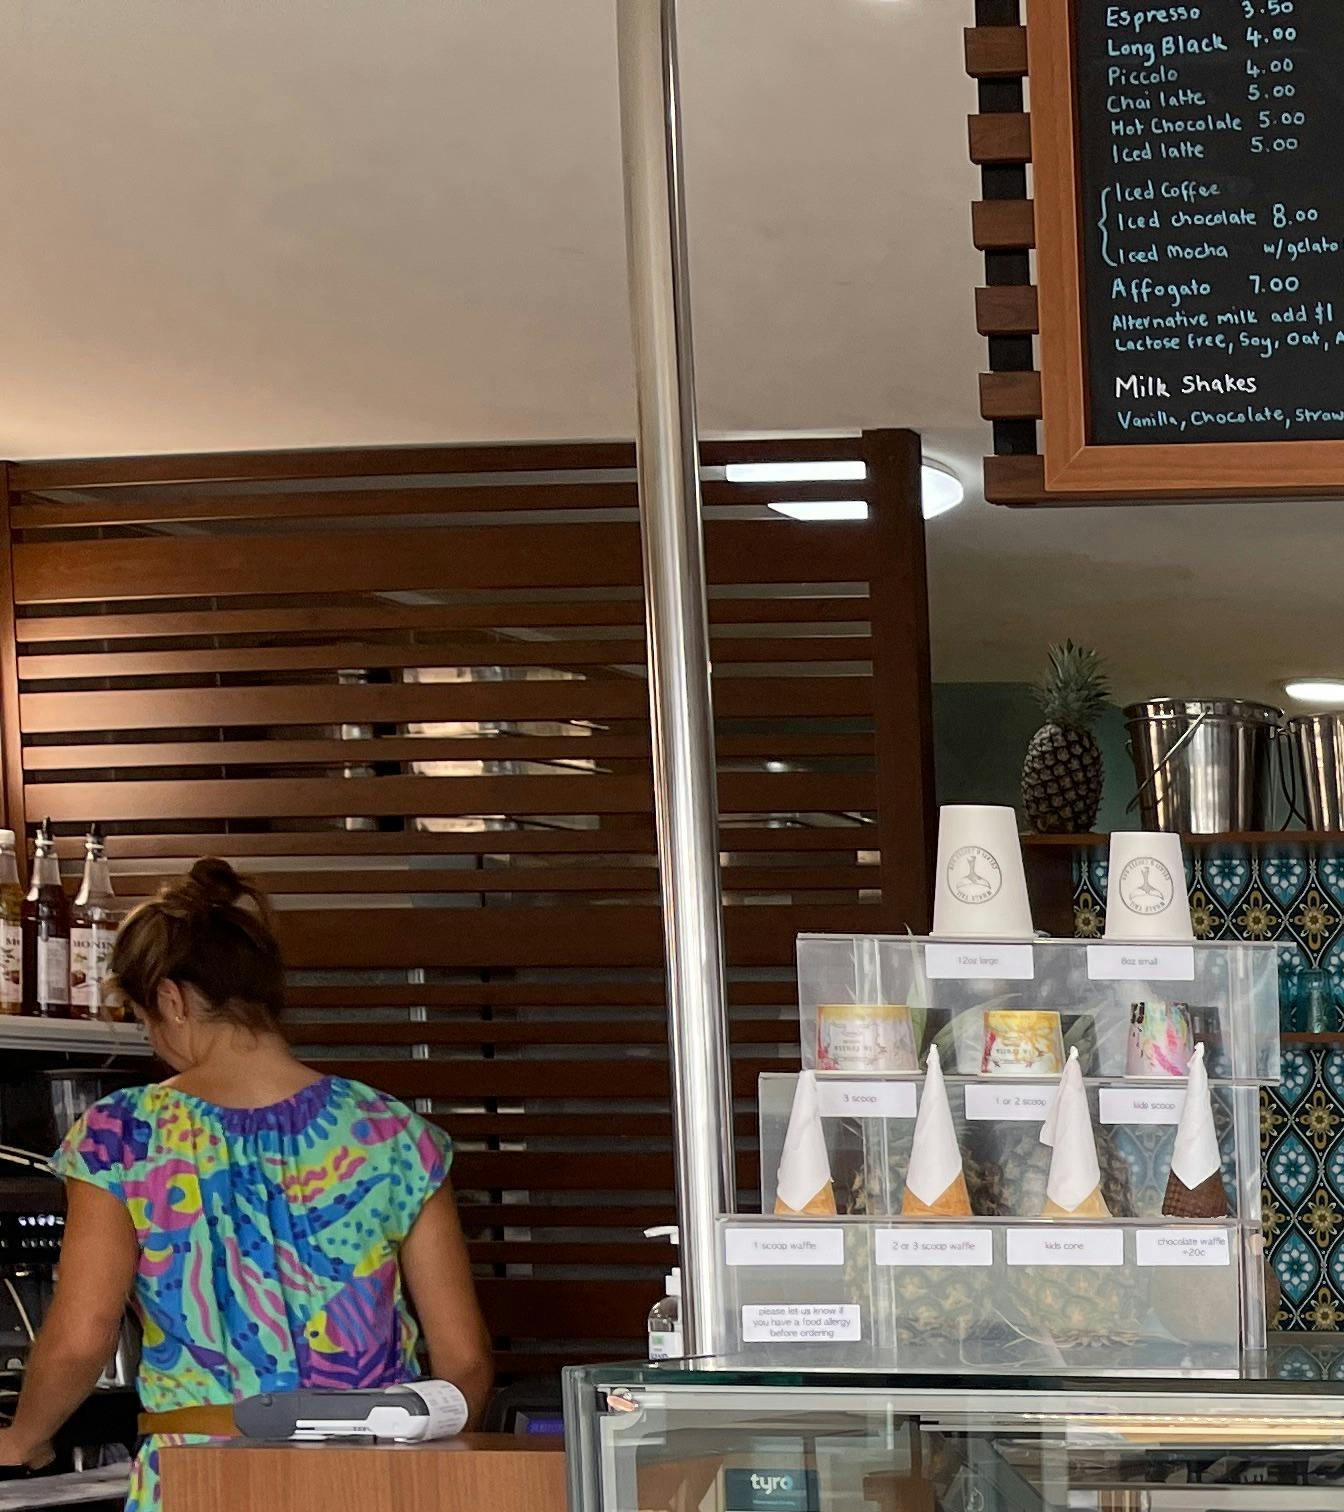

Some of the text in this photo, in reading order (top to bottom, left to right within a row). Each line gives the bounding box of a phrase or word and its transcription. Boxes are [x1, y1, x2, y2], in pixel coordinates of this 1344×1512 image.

[1107, 0, 1293, 32] Espresso 3.50
[1108, 27, 1296, 66] Long Black 4.00
[1109, 58, 1293, 85] Piccolo 4.00
[1107, 91, 1150, 112] Chai
[1248, 85, 1295, 100] 5.00
[1112, 119, 1144, 135] Hot
[1260, 111, 1304, 127] 5.00
[1113, 142, 1151, 163] Iced
[1251, 137, 1297, 152] 5.00
[1116, 180, 1219, 202] Iced Coffee
[1119, 204, 1317, 230] Iced chocolate 8.00
[1120, 244, 1158, 263] Iced
[1112, 275, 1298, 306] Affogato 7.00
[1113, 302, 1332, 330] Alternative milk add $1
[1116, 336, 1179, 351] Lactose
[1116, 374, 1256, 398] Milk Shakes
[1118, 411, 1186, 431] Vanilla,
[1191, 407, 1290, 428] Chocolate,
[1138, 956, 1158, 966] small
[852, 1095, 877, 1107] scoop
[1044, 1241, 1061, 1250] kids
[1158, 1237, 1226, 1246] chocolate waffle
[750, 1473, 794, 1495] tyro
